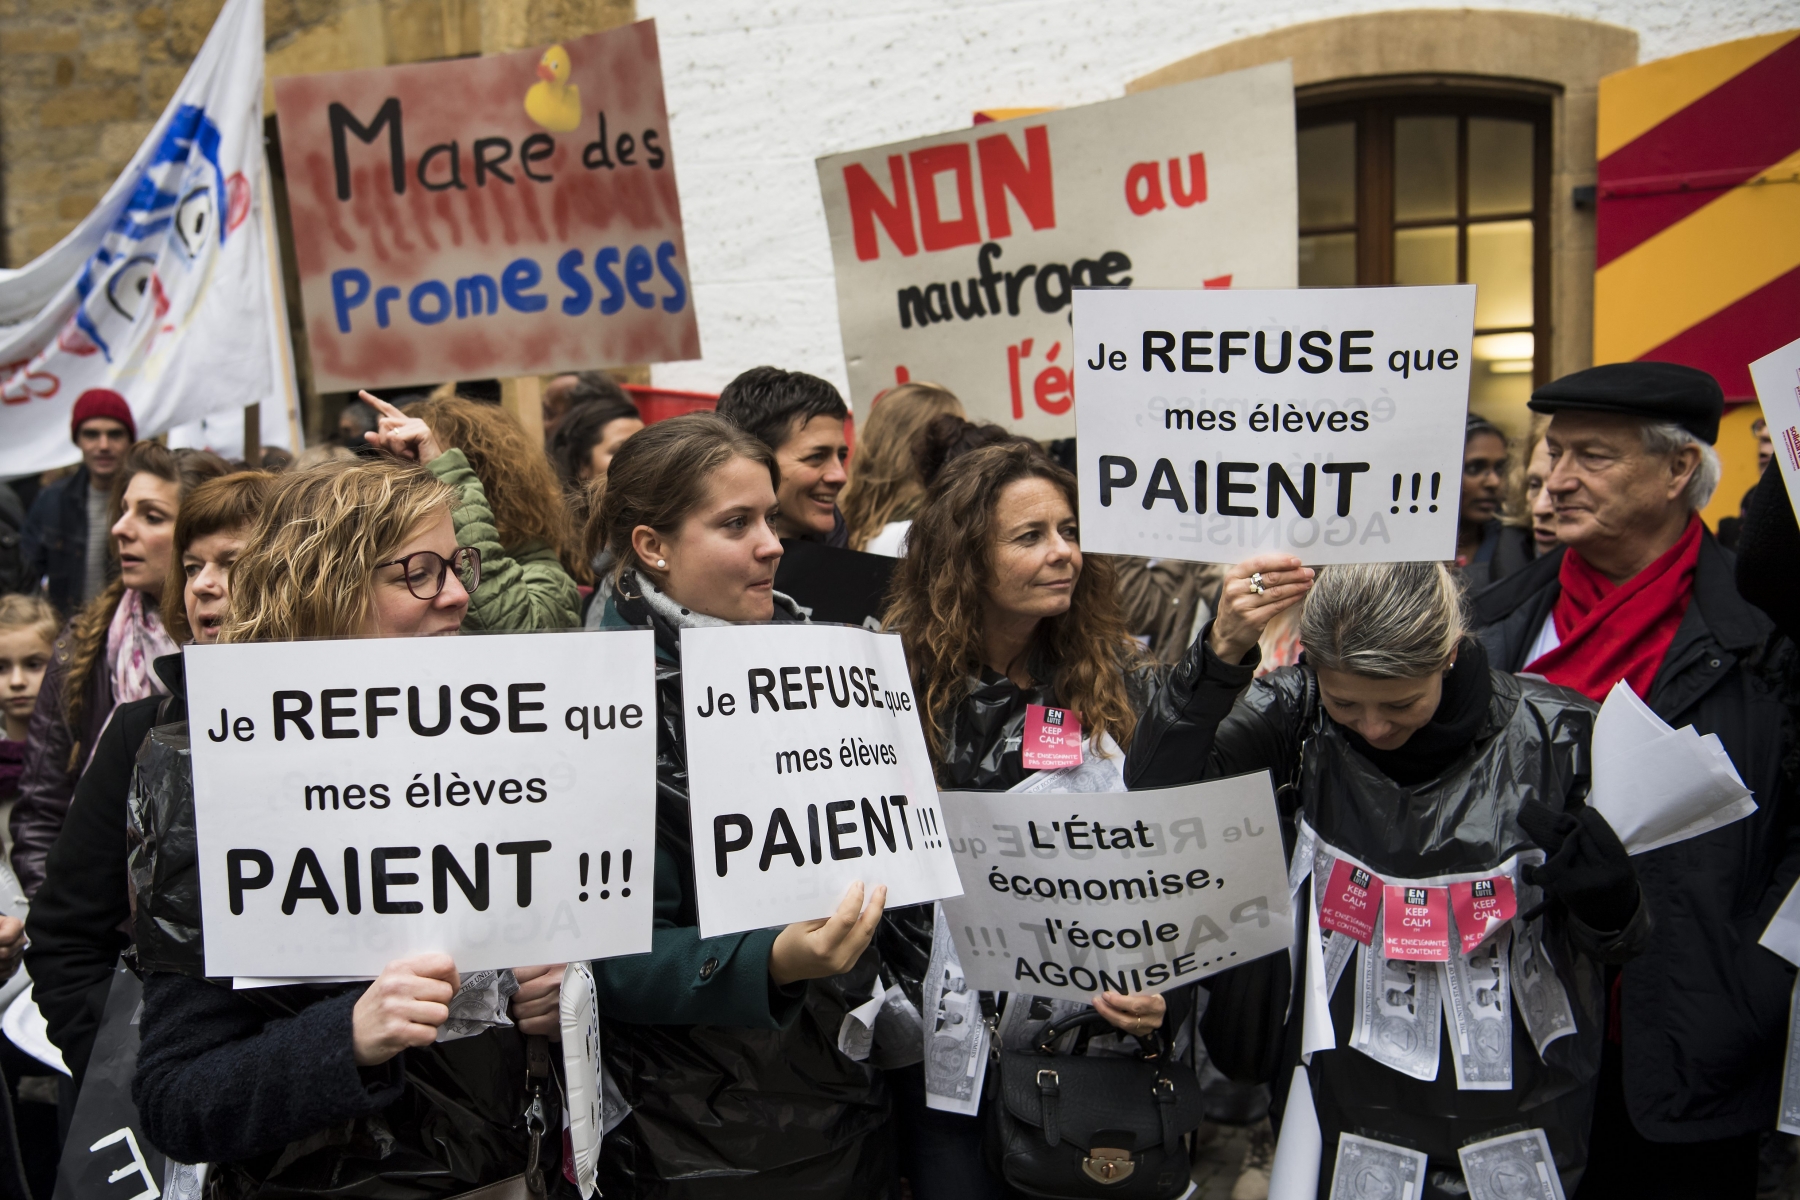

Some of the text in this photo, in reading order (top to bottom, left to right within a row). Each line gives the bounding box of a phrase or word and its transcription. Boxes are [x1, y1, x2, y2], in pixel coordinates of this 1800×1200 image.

[582, 111, 665, 170] des
[843, 125, 1208, 262] NON au
[332, 241, 687, 333] Promesses
[898, 243, 1132, 329] naufrage
[1087, 342, 1128, 371] Je
[1142, 330, 1375, 374] REFUSE
[1388, 347, 1460, 379] que
[1006, 338, 1074, 420] l'é
[1164, 403, 1370, 433] mes élèves
[1098, 455, 1371, 518] PAIENT
[1390, 471, 1442, 515] !!!
[697, 665, 912, 718] Je REFUSE que
[207, 682, 644, 743] Je REFUSE que
[1042, 726, 1062, 735] KEEP
[1048, 709, 1062, 718] EN
[775, 737, 897, 775] mes élèves
[1039, 735, 1064, 745] CALM
[304, 772, 548, 811] mes élèves
[713, 795, 943, 878] PAIENT !!!
[1029, 814, 1155, 850] L'État
[226, 839, 633, 916] PAIENT !!!
[988, 865, 1225, 901] économise,
[1347, 885, 1367, 898] KEEP
[1356, 869, 1370, 881] EN
[1476, 881, 1491, 890] EN
[1342, 894, 1367, 910] CALM
[1405, 907, 1428, 916] KEEP
[1408, 889, 1425, 898] EN
[1473, 899, 1497, 910] KEEP
[1402, 917, 1431, 927] CALM
[1473, 909, 1501, 920] CALM
[1045, 917, 1180, 952] l'école
[462, 970, 495, 992] THE UNIT
[1014, 951, 1238, 995] AGONISE...
